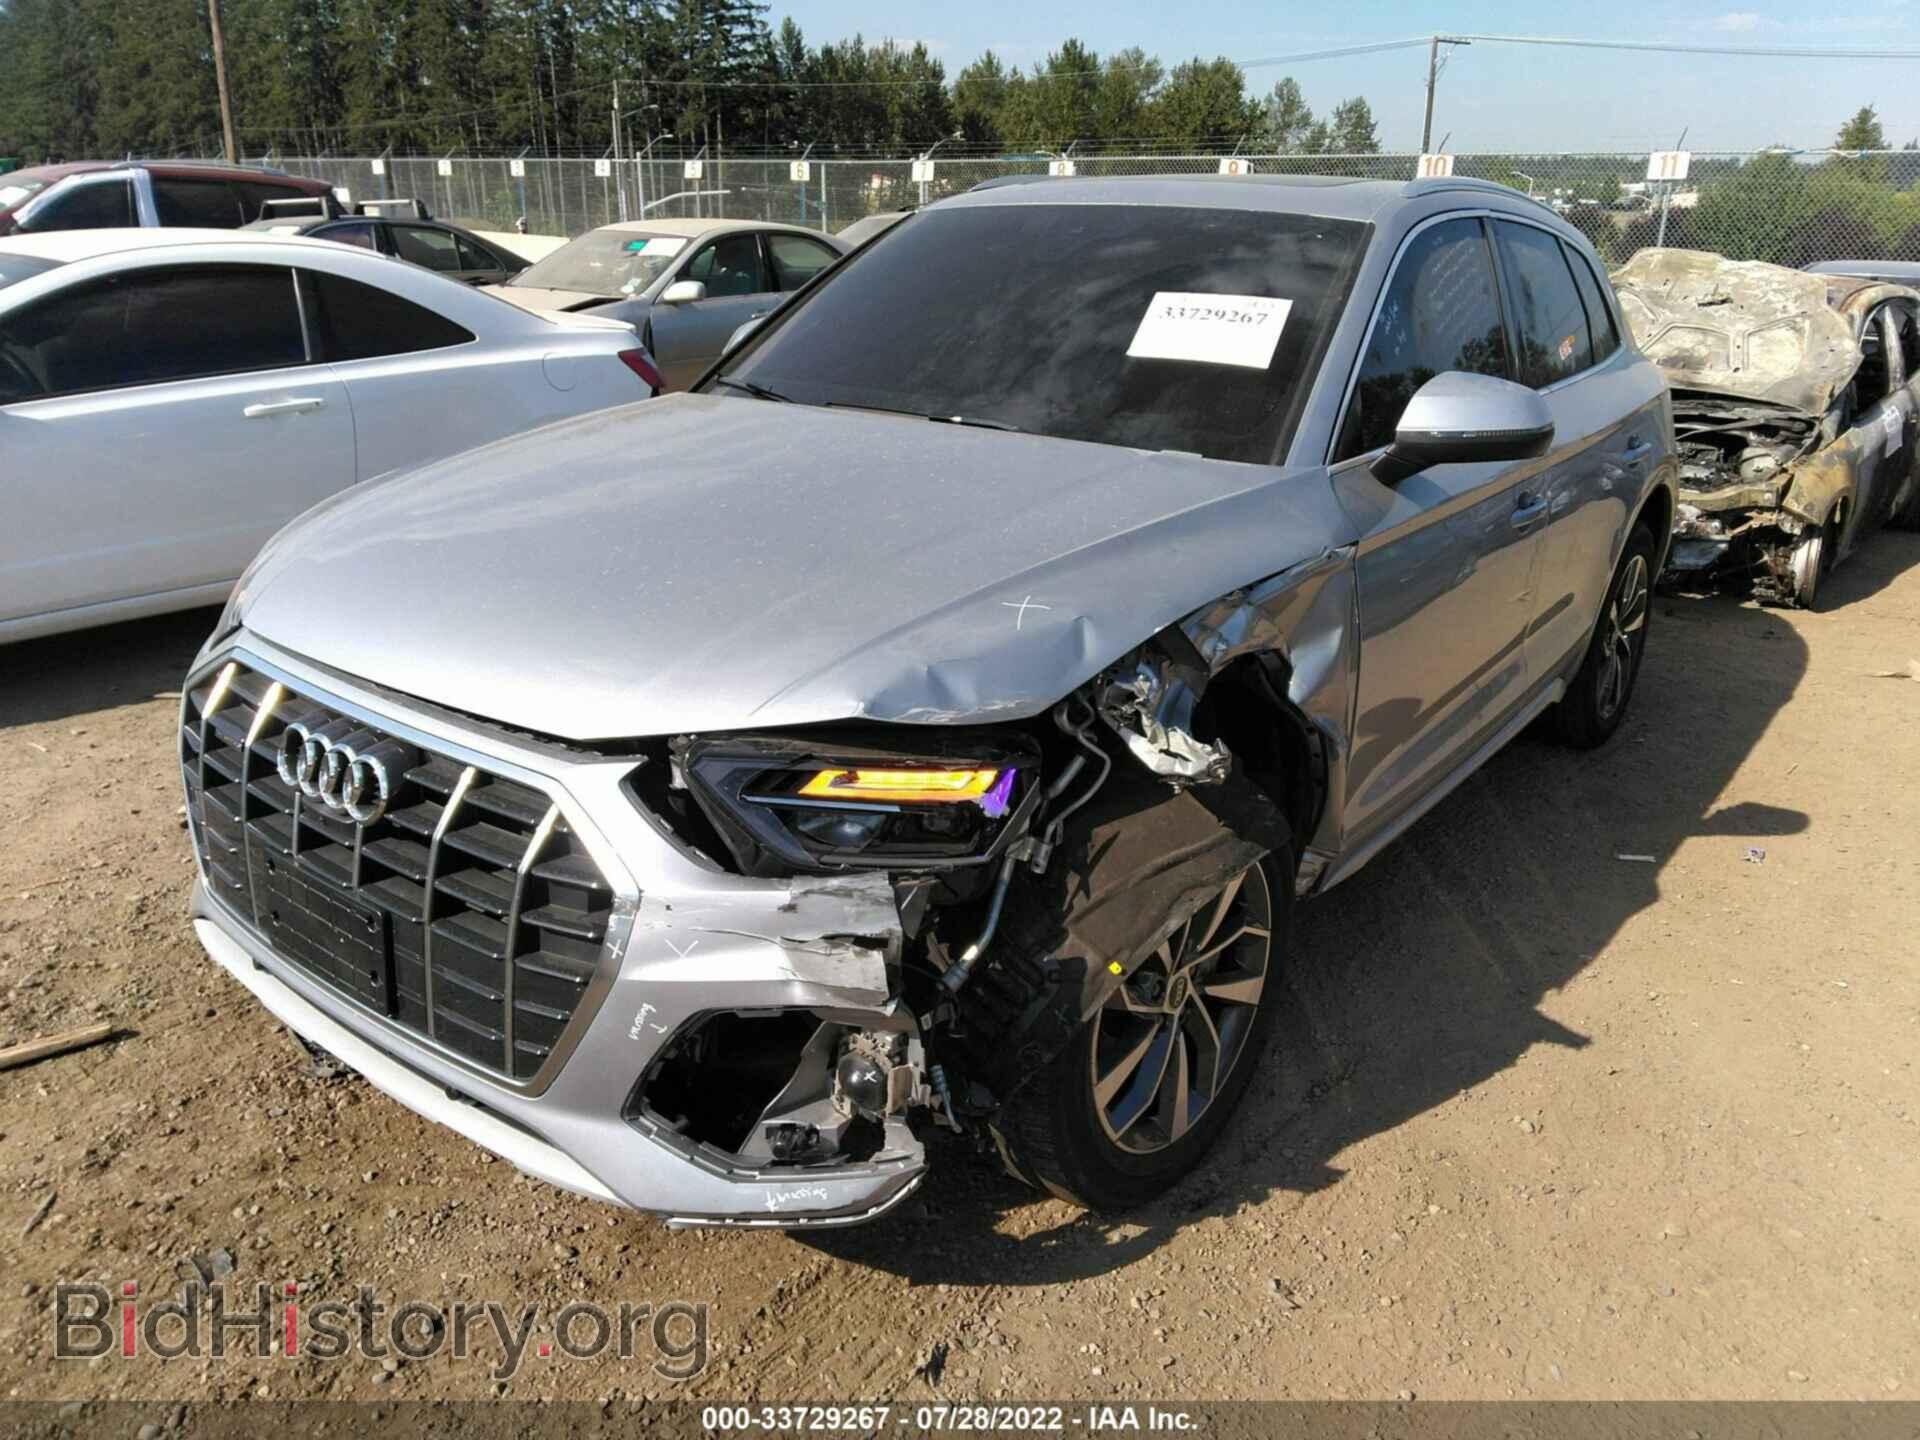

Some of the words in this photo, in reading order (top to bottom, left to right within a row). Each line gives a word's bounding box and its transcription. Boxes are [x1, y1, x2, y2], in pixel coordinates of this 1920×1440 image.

[1424, 156, 1448, 177] 10
[1659, 154, 1681, 177] 11
[1160, 305, 1269, 326] 33729267
